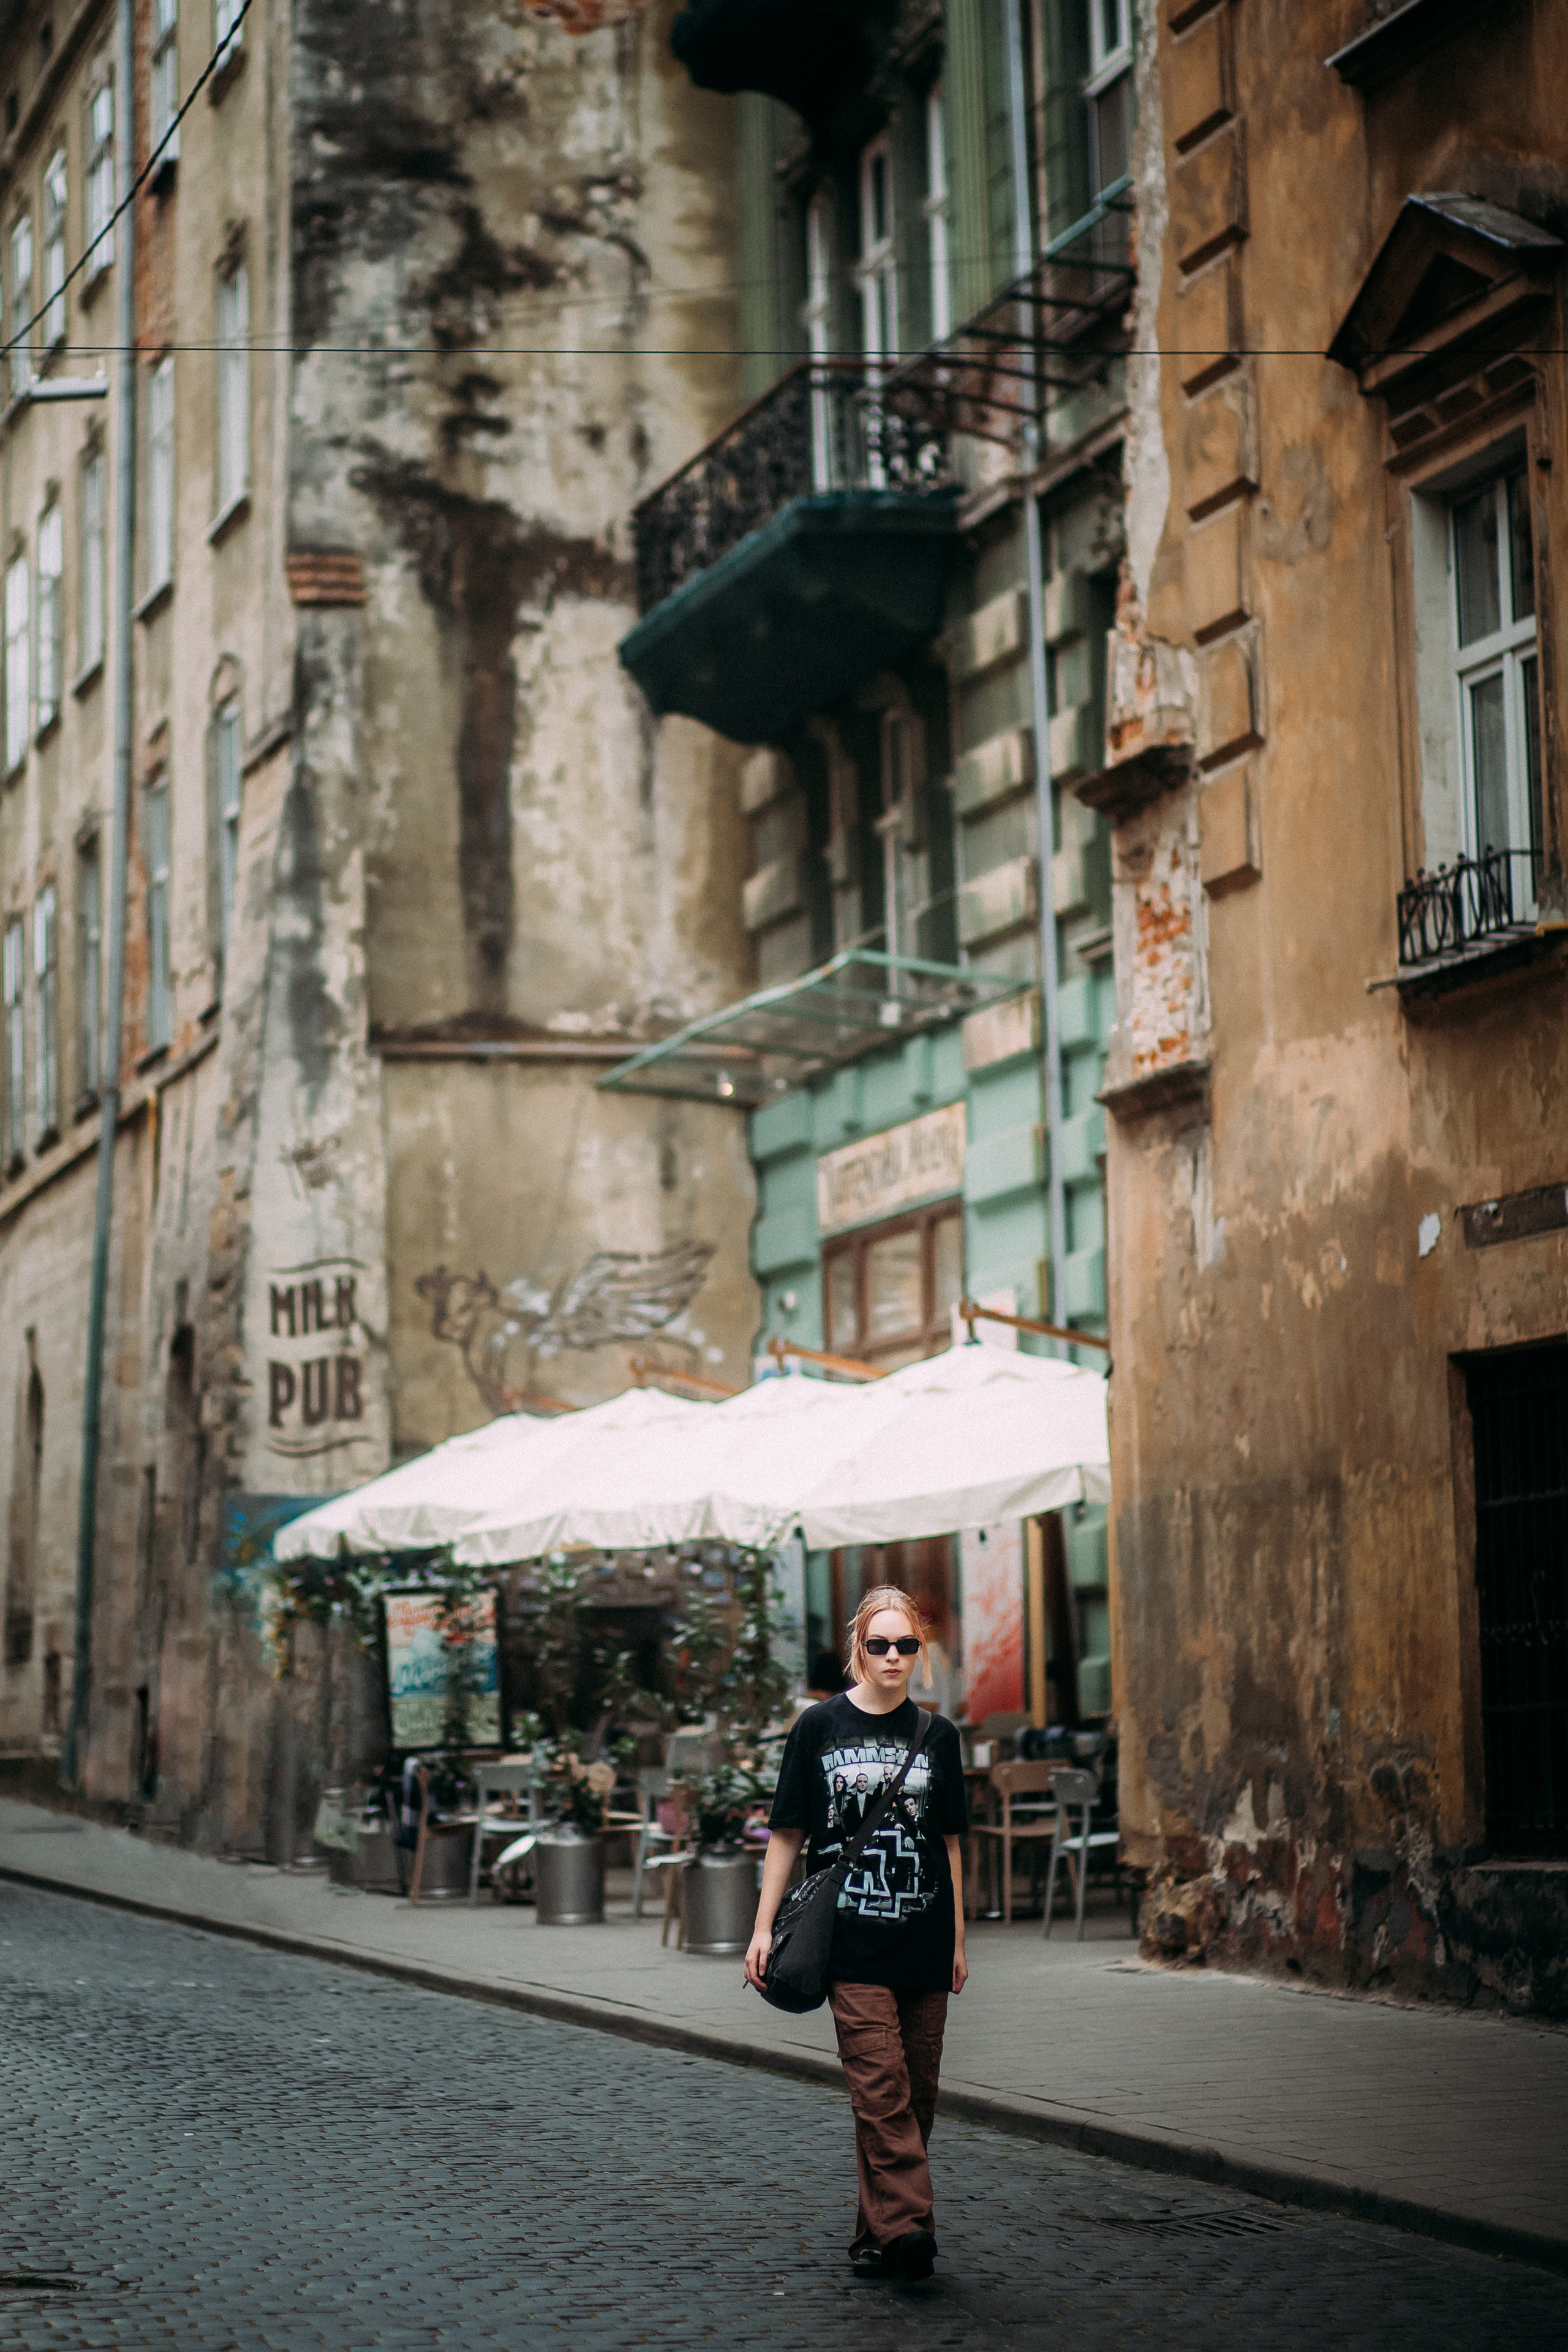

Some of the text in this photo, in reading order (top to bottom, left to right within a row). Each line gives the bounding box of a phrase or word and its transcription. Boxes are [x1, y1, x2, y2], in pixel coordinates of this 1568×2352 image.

[270, 1276, 356, 1336] MILK
[269, 1357, 362, 1427] PUB
[821, 1747, 929, 1771] RAMMSTEN
